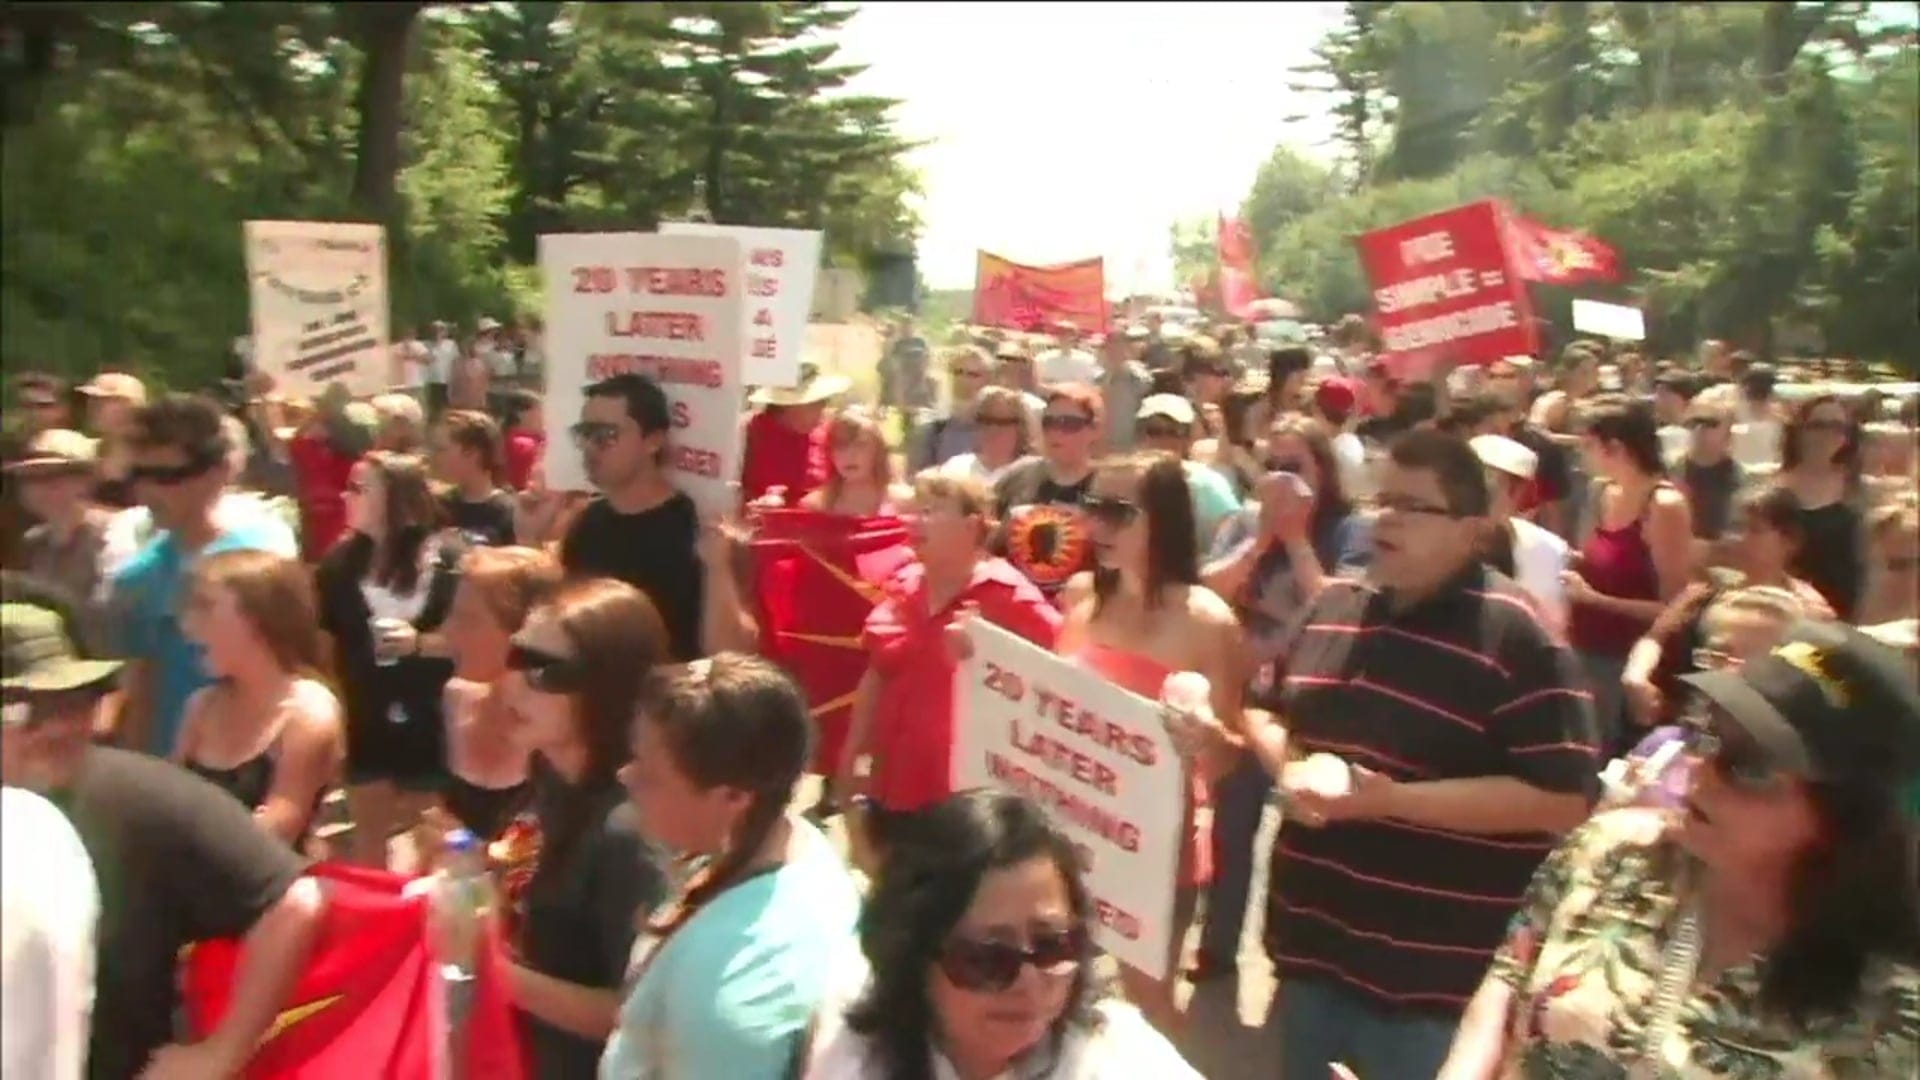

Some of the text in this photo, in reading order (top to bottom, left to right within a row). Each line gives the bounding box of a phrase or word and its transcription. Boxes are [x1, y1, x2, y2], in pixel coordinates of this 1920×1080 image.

[571, 267, 617, 294] 20
[625, 267, 726, 297] YEARS
[605, 311, 704, 341] LATER
[983, 661, 1157, 767] 20 YEARS
[1009, 719, 1119, 797] LATER
